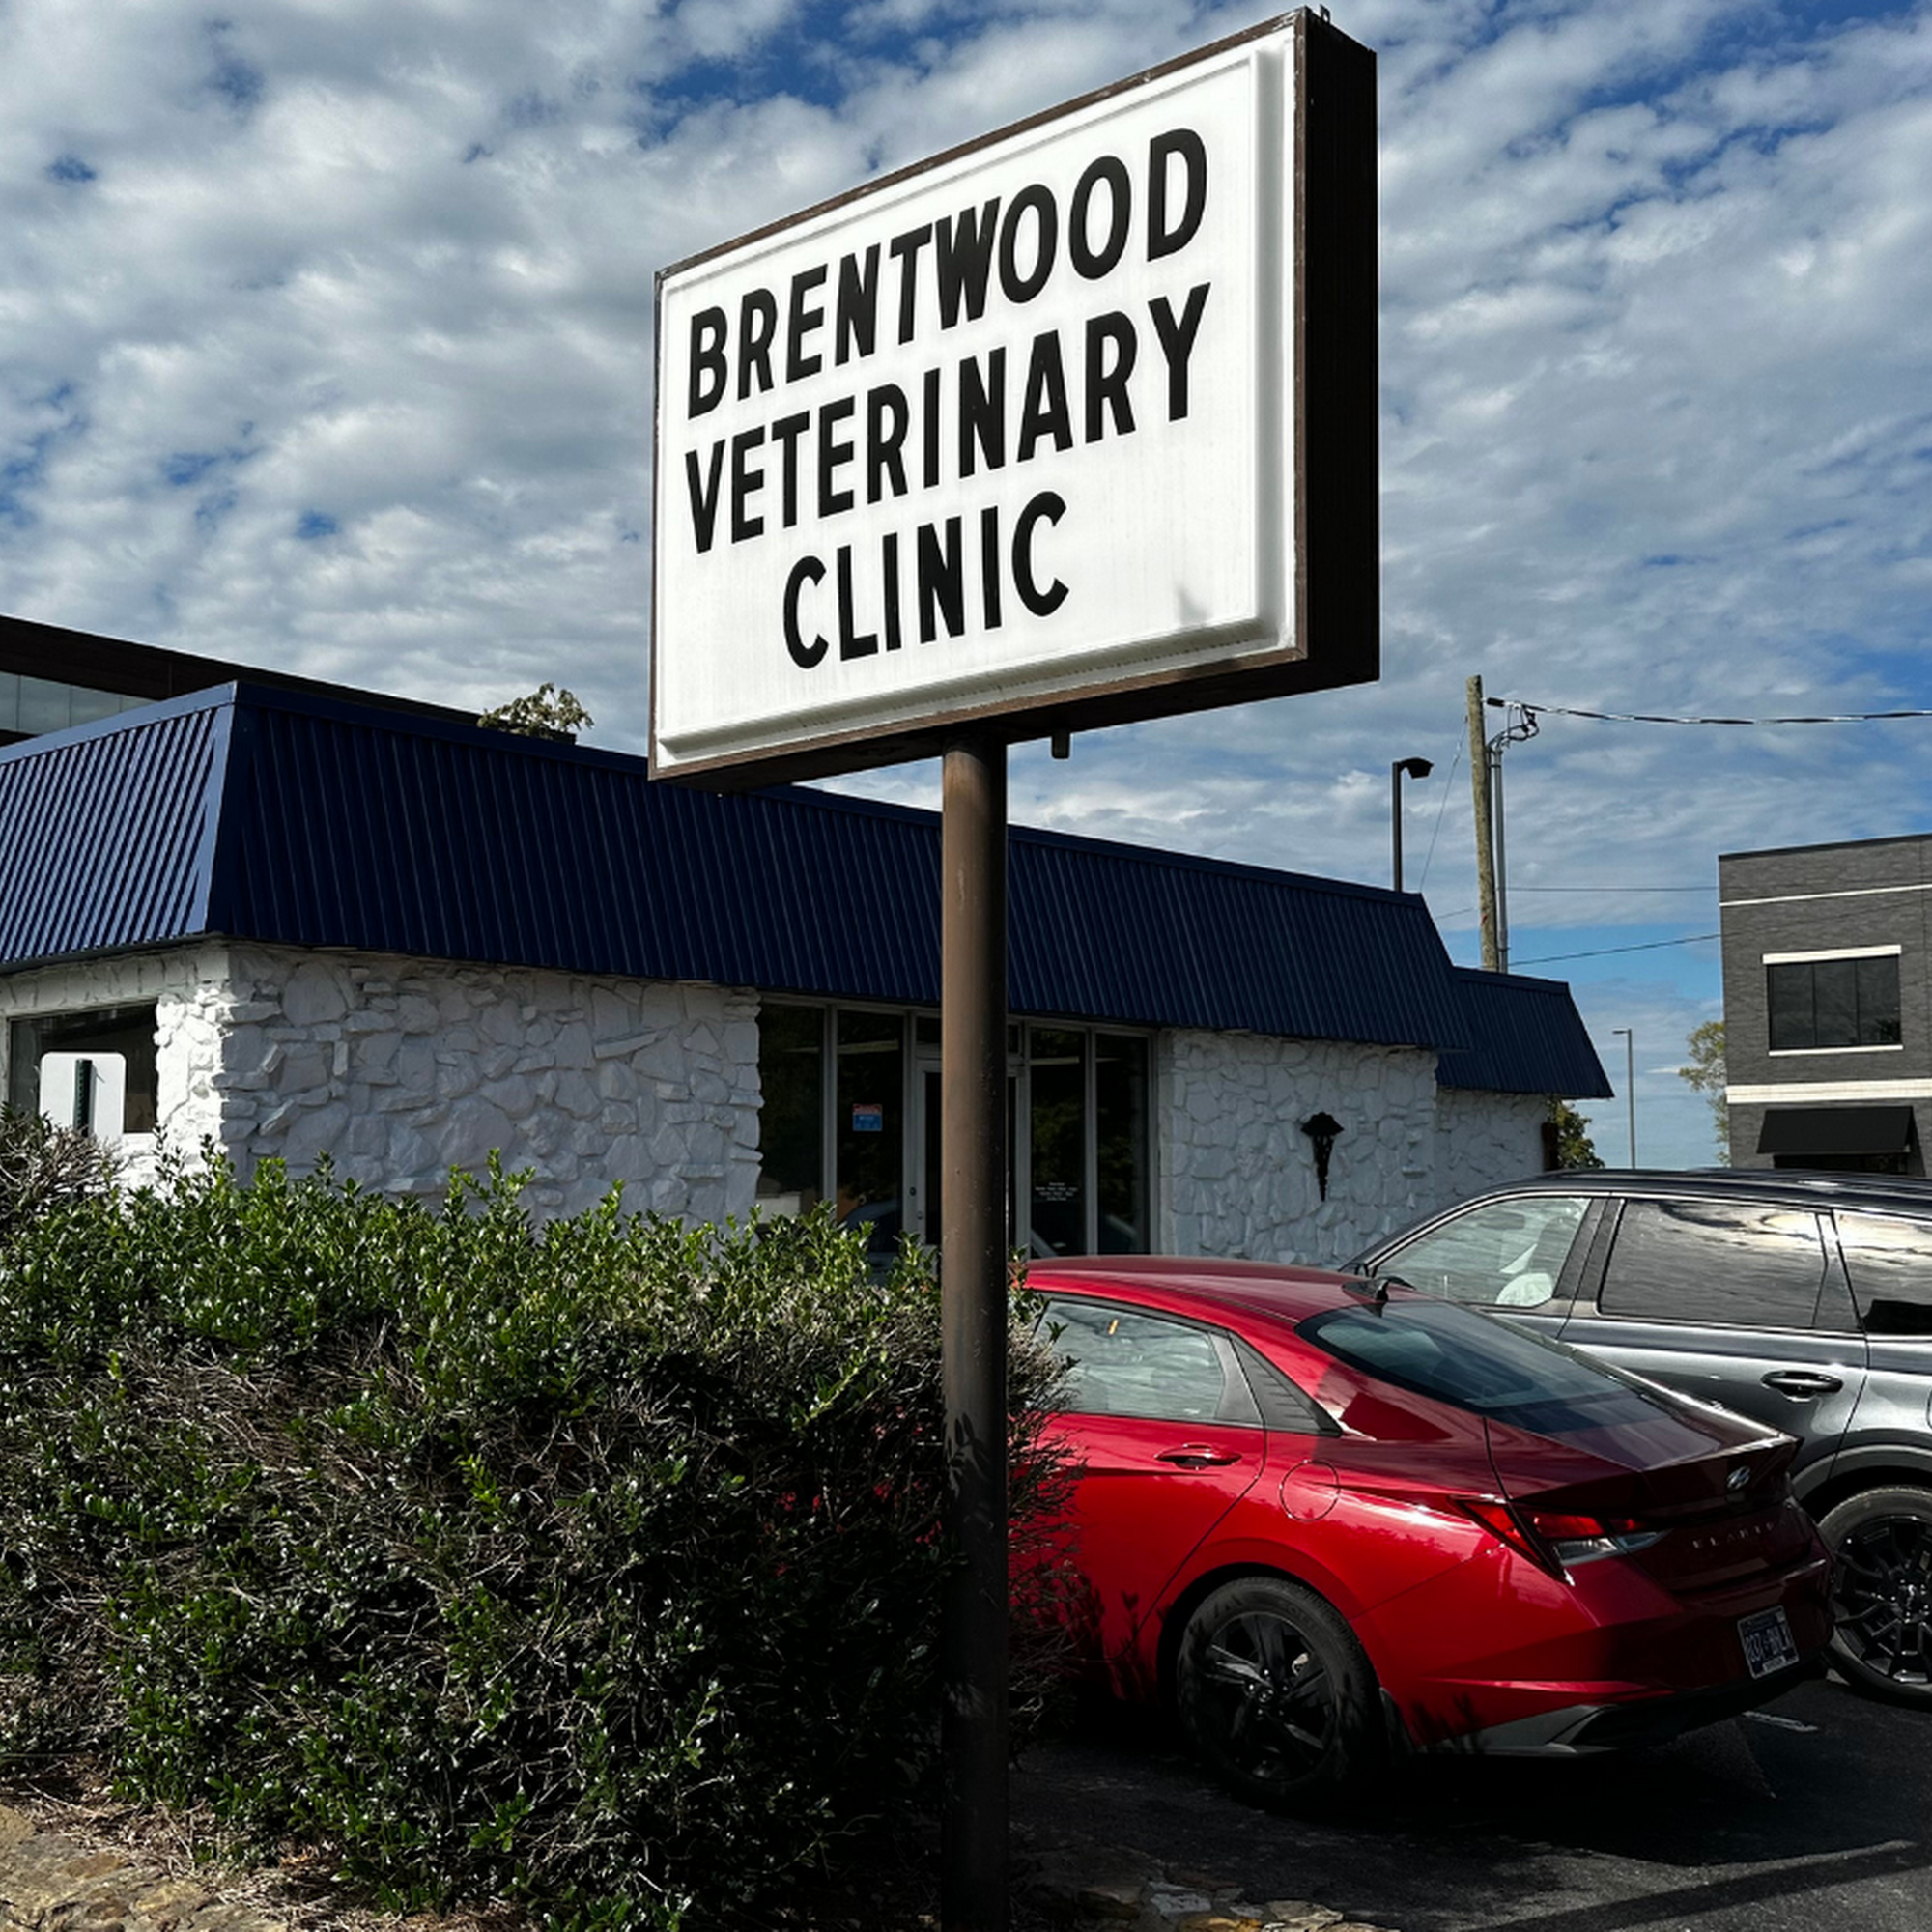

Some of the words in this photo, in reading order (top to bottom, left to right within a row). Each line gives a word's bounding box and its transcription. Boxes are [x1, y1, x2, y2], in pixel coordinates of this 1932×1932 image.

[688, 128, 1208, 420] BRENTWOOD
[685, 282, 1211, 554] VETERINARY
[783, 491, 1069, 669] CLINIC
